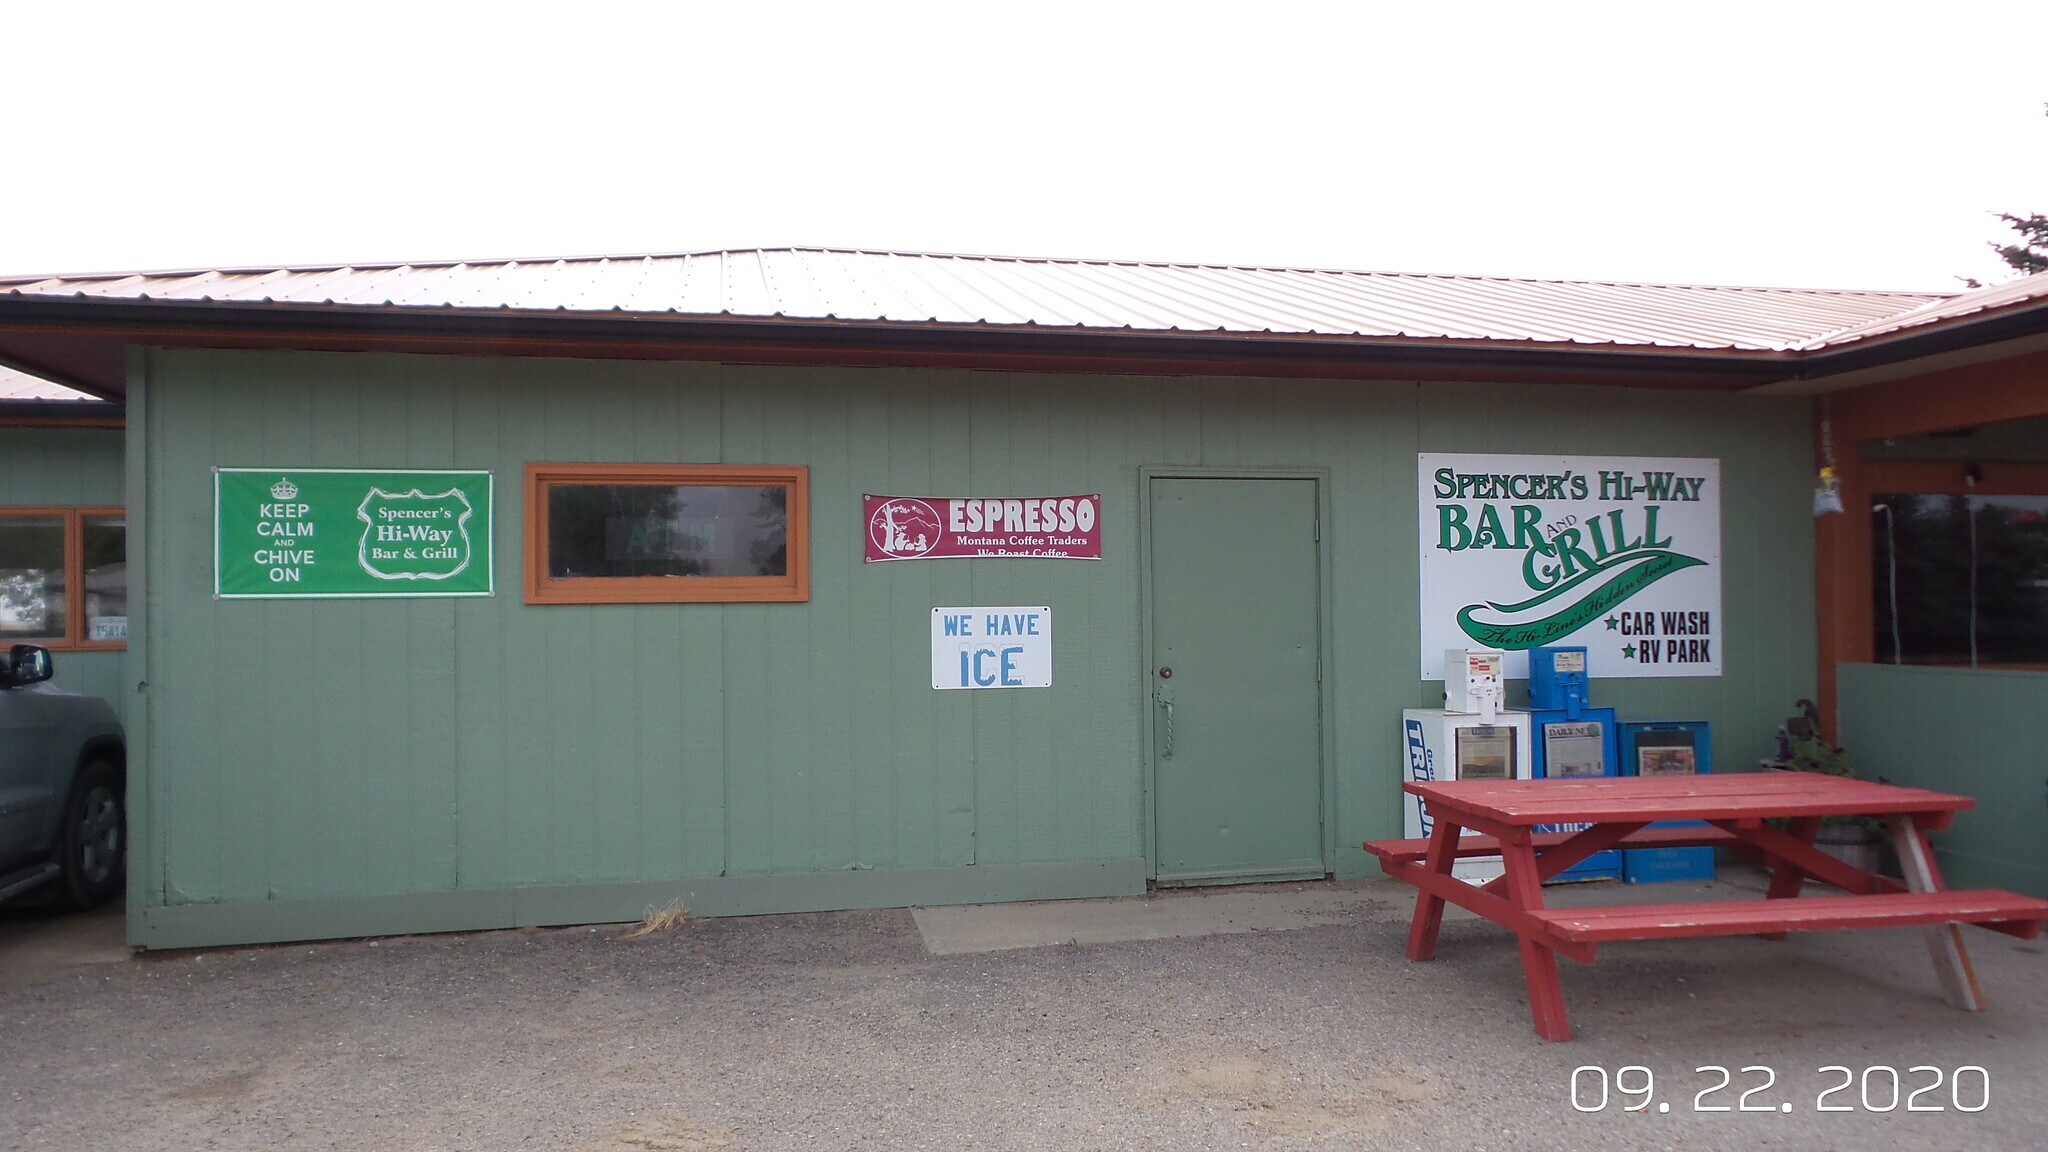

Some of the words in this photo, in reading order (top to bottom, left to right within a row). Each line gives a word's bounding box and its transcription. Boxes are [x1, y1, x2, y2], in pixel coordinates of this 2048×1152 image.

[1434, 468, 1589, 501] SPENCER'S
[1598, 470, 1705, 501] HI-WAY
[260, 503, 310, 518] KEEP
[378, 506, 452, 522] Spencer's
[949, 498, 1095, 533] ESPRESSO
[256, 521, 314, 537] CALM
[376, 525, 453, 546] Hi-Way
[1436, 503, 1553, 553] BAR
[1545, 514, 1577, 538] AND
[274, 538, 295, 547] AND
[626, 523, 716, 553] ATM
[956, 535, 1005, 546] Montana
[1009, 535, 1045, 546] Coffee
[1046, 535, 1088, 546] Traders
[1522, 505, 1673, 591] GRILL
[254, 549, 315, 565] CHIVE
[372, 547, 399, 559] Bar
[403, 547, 418, 559] &
[421, 547, 458, 559] Grill
[977, 548, 994, 557] We
[269, 567, 300, 582] ON
[1478, 627, 1512, 645] The
[1584, 583, 1635, 620] Hidden
[1621, 612, 1655, 636] CAR
[1661, 611, 1710, 636] WASH
[944, 614, 973, 637] WE
[986, 614, 1040, 636] HAVE
[1639, 640, 1661, 664] RV
[1667, 638, 1711, 664] PARK
[959, 643, 1025, 687] ICE
[1549, 727, 1573, 737] DAILY
